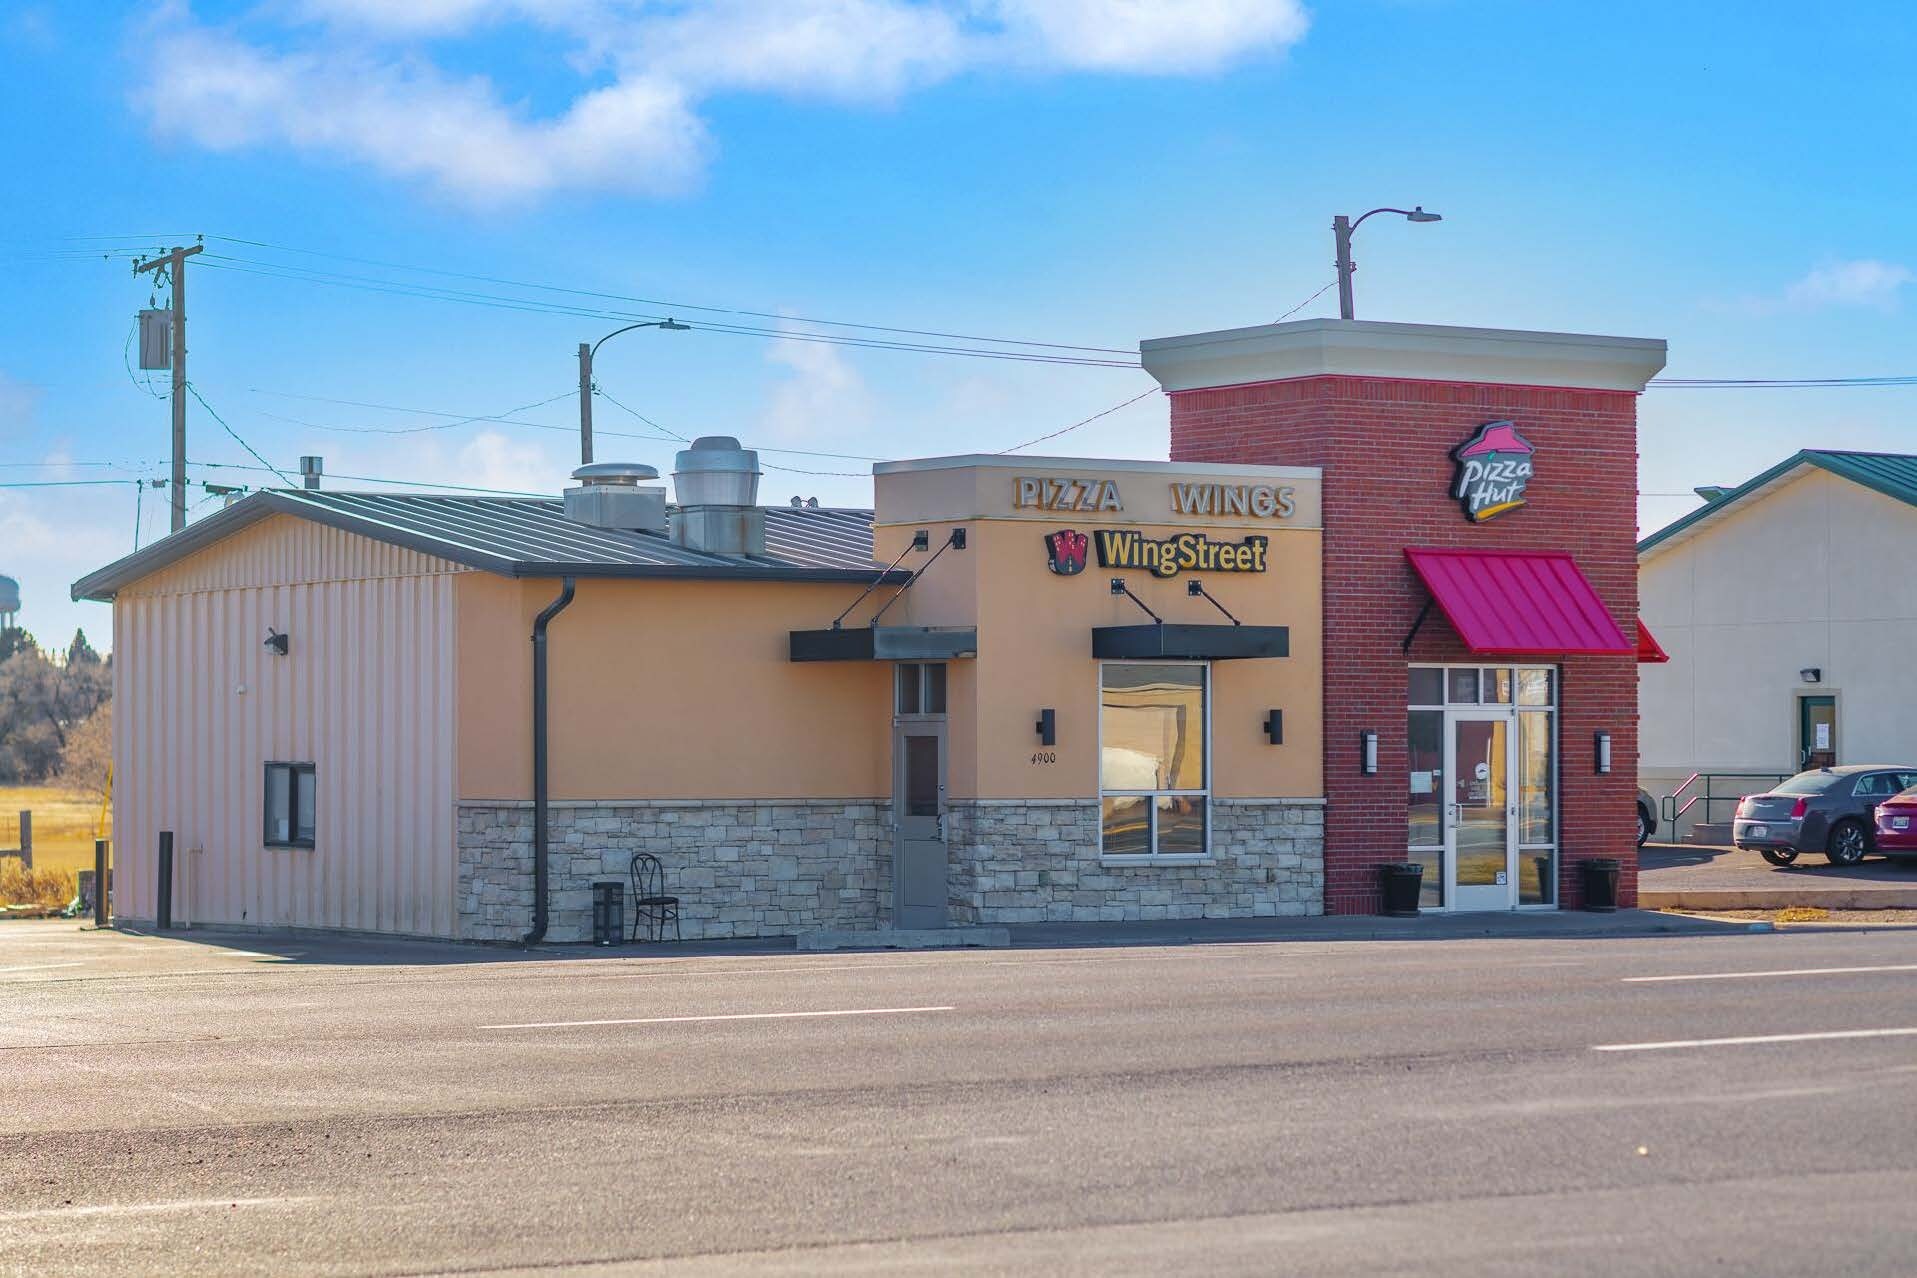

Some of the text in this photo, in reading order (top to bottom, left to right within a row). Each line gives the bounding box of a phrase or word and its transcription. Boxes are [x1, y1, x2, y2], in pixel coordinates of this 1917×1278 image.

[1014, 477, 1296, 519] PIZZA WINGS
[1460, 460, 1532, 498] Pizza
[1471, 481, 1524, 510] Hut
[1103, 531, 1265, 577] WingStreet
[1031, 752, 1056, 765] 4900
